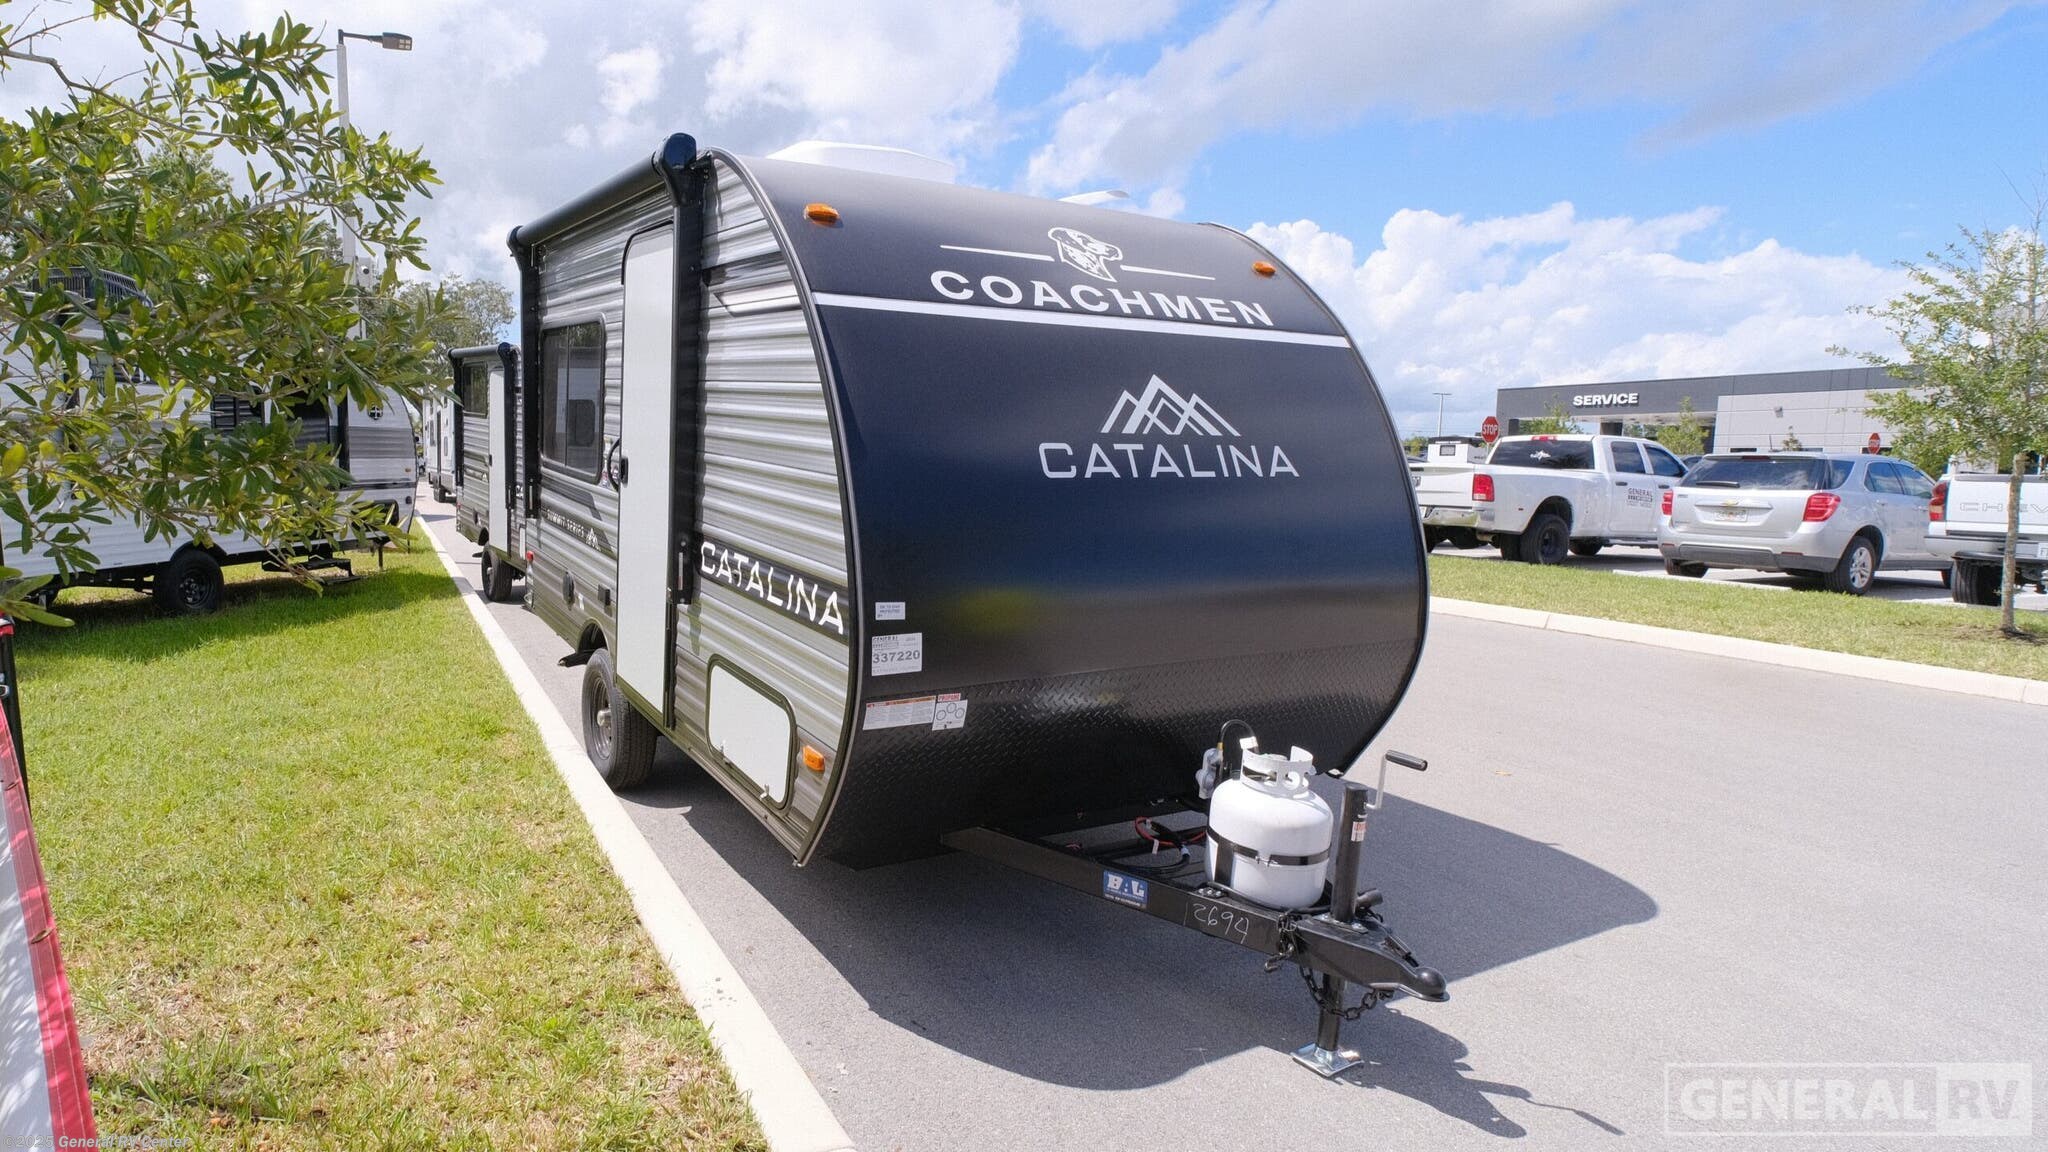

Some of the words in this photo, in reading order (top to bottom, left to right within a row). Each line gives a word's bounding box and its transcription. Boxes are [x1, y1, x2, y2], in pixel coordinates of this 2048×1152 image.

[930, 270, 1275, 326] COACHMEN
[1573, 392, 1639, 406] SERVICE
[1482, 424, 1498, 435] STOP
[1038, 443, 1300, 478] CATALINA
[567, 519, 584, 538] SERIES
[701, 541, 844, 635] CATALINA
[872, 650, 920, 664] 337220
